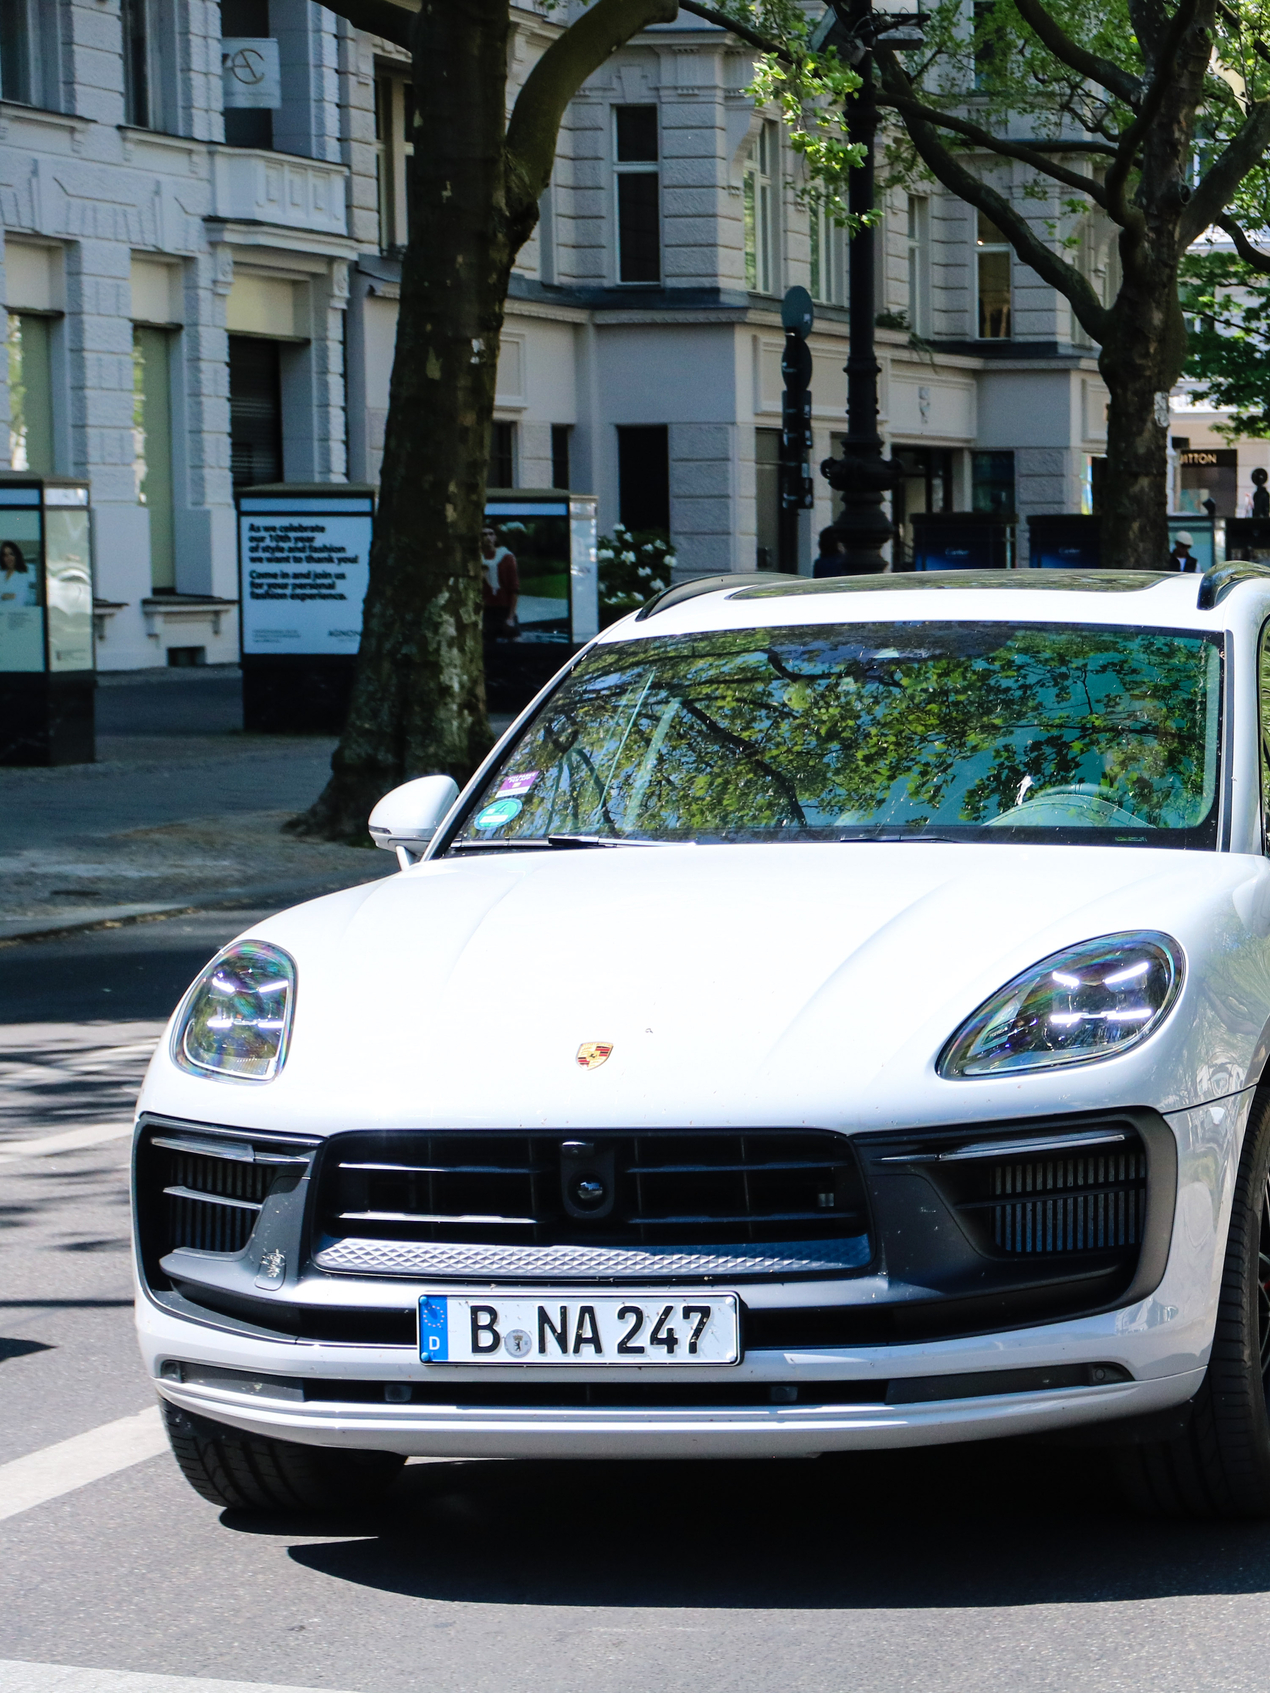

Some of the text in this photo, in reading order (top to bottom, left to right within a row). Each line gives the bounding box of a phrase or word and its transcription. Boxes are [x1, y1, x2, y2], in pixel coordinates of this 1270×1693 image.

[249, 523, 261, 533] As
[279, 523, 326, 533] celebrate
[269, 534, 292, 543] 10th
[294, 536, 316, 545] year
[248, 544, 347, 555] of style and fashion
[292, 555, 303, 563] to
[305, 554, 335, 564] thank
[335, 554, 359, 566] you!
[249, 570, 278, 579] Come
[280, 570, 290, 579] in
[292, 570, 311, 579] and
[312, 570, 333, 581] join
[250, 580, 336, 592] for your personal
[250, 590, 348, 602] fashion experience.
[470, 1305, 712, 1354] B NA 247
[429, 1336, 440, 1351] D
